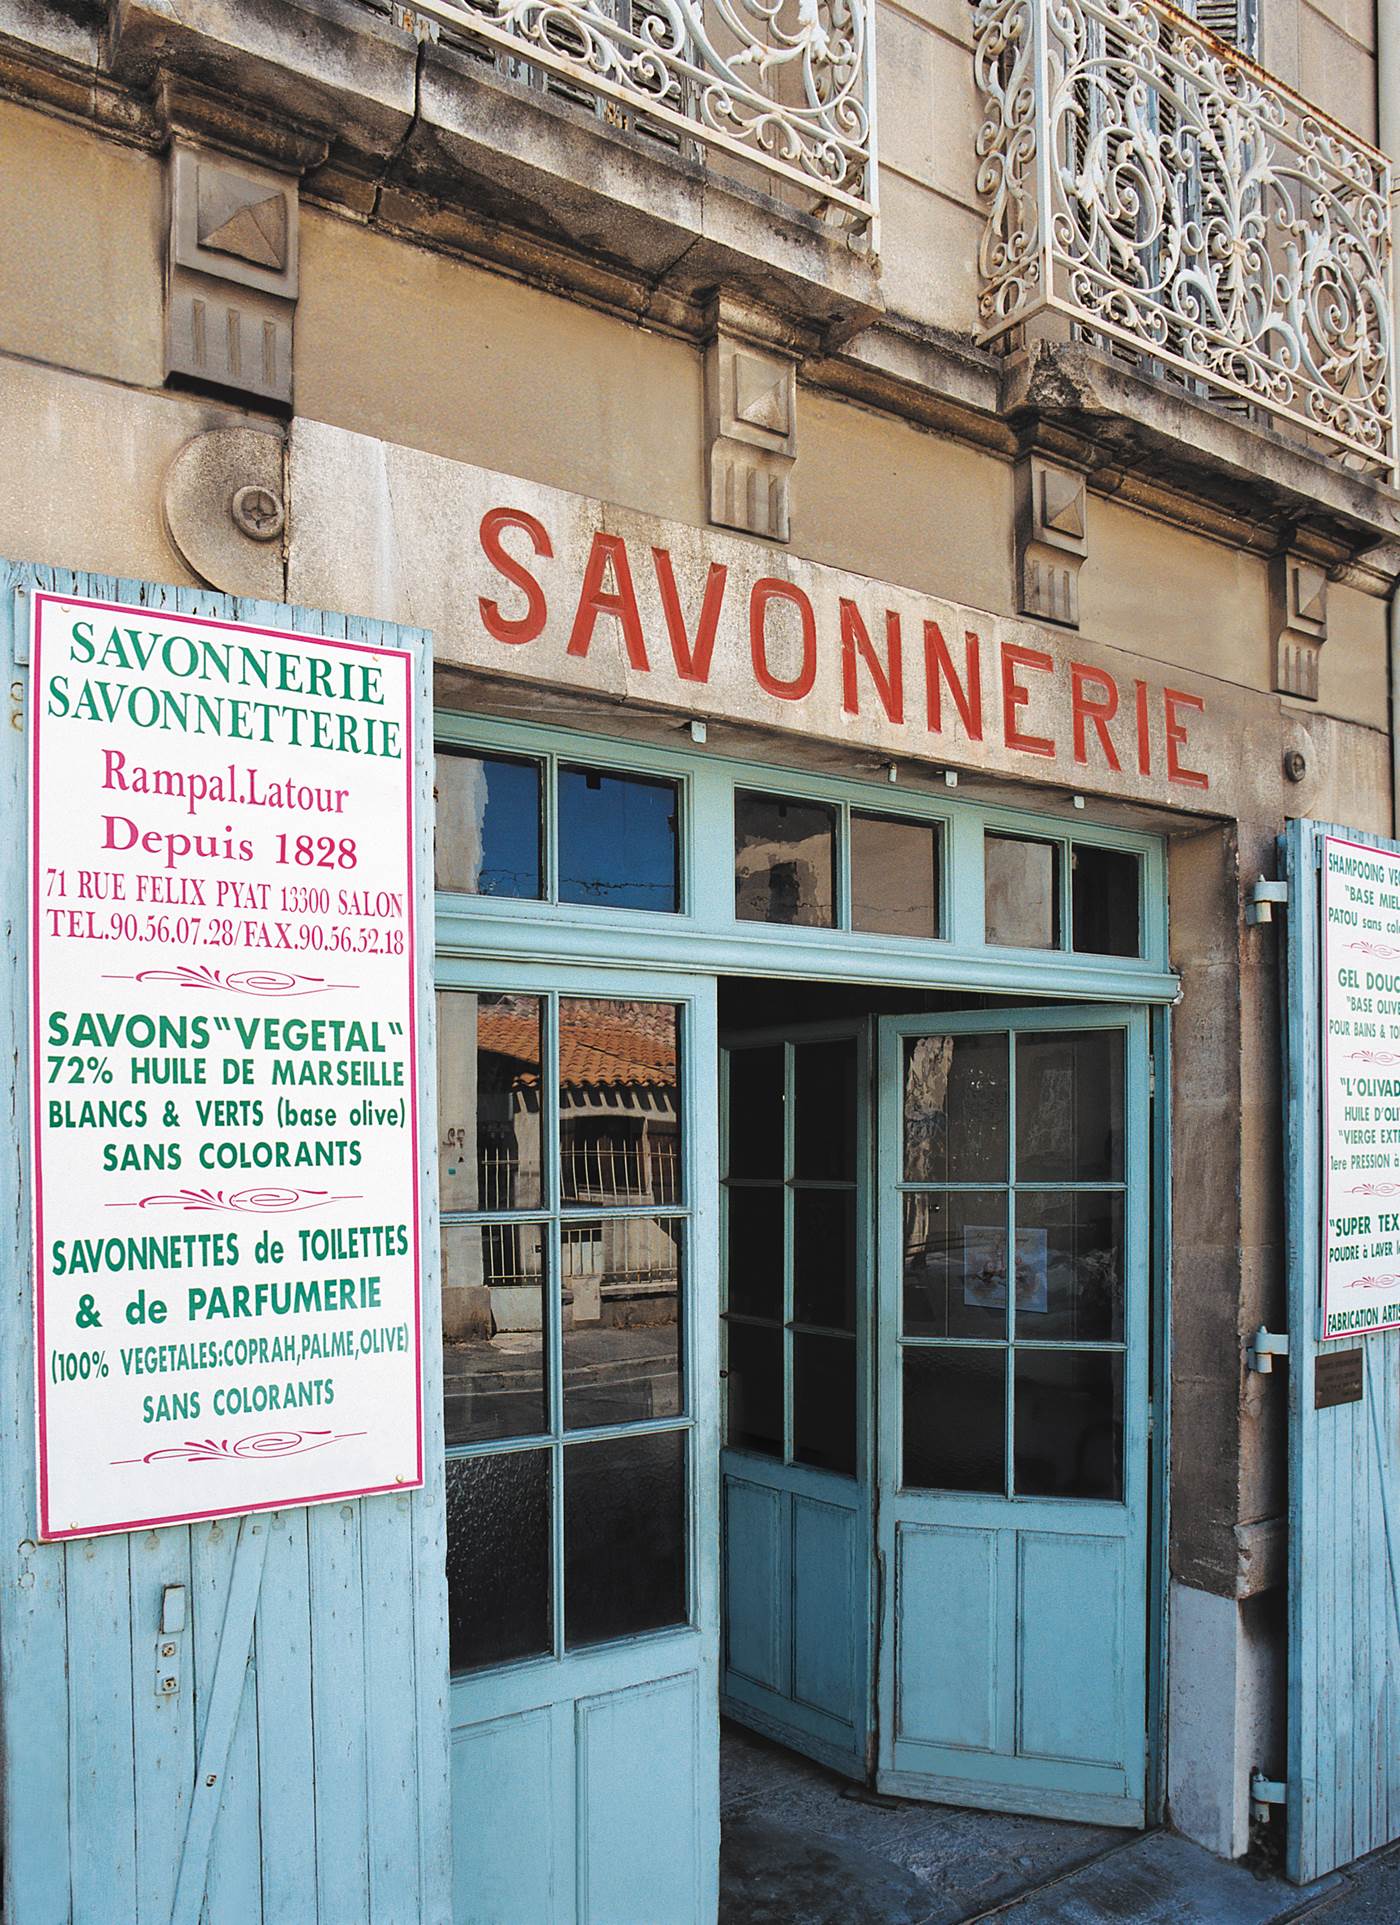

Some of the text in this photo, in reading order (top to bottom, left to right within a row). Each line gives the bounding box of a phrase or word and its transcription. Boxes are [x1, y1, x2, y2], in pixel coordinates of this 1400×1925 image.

[70, 623, 385, 705] SAVONNERIE
[479, 506, 1210, 790] SAVONNERIE
[47, 675, 401, 760] SAVONNETTERIE
[101, 749, 350, 815] Rampal.Latour
[100, 815, 358, 871] Depuis 1828
[1328, 853, 1384, 883] SHAMPOOING
[47, 867, 403, 918] 71 RUE FELIX PYAT 13300 SALON
[1328, 907, 1358, 926] PATOU
[1362, 918, 1382, 931] sans
[1338, 968, 1359, 988] GEL
[1329, 1019, 1350, 1036] POUR
[1354, 1022, 1376, 1037] BAINS
[1380, 1024, 1385, 1038] &
[47, 1055, 404, 1087] 72% HUILE DE MARSEILLE
[48, 1097, 405, 1129] BLANCS & VERTS (base olive)
[1345, 1106, 1400, 1121] HUILE D'OLI
[102, 1140, 363, 1172] SANS COLORANTS
[1351, 1154, 1390, 1169] PRESSION
[1378, 1213, 1400, 1232] TEX
[51, 1224, 409, 1277] SAVONNETTES de TOILETTES
[1329, 1245, 1359, 1263] POUDRE
[1363, 1244, 1368, 1258] à
[1371, 1242, 1393, 1258] LAVER
[75, 1276, 382, 1329] & de PARFUMERIE
[1328, 1307, 1379, 1332] FABRICATION
[52, 1350, 109, 1384] (100%
[143, 1378, 335, 1424] SANS COLORANTS
